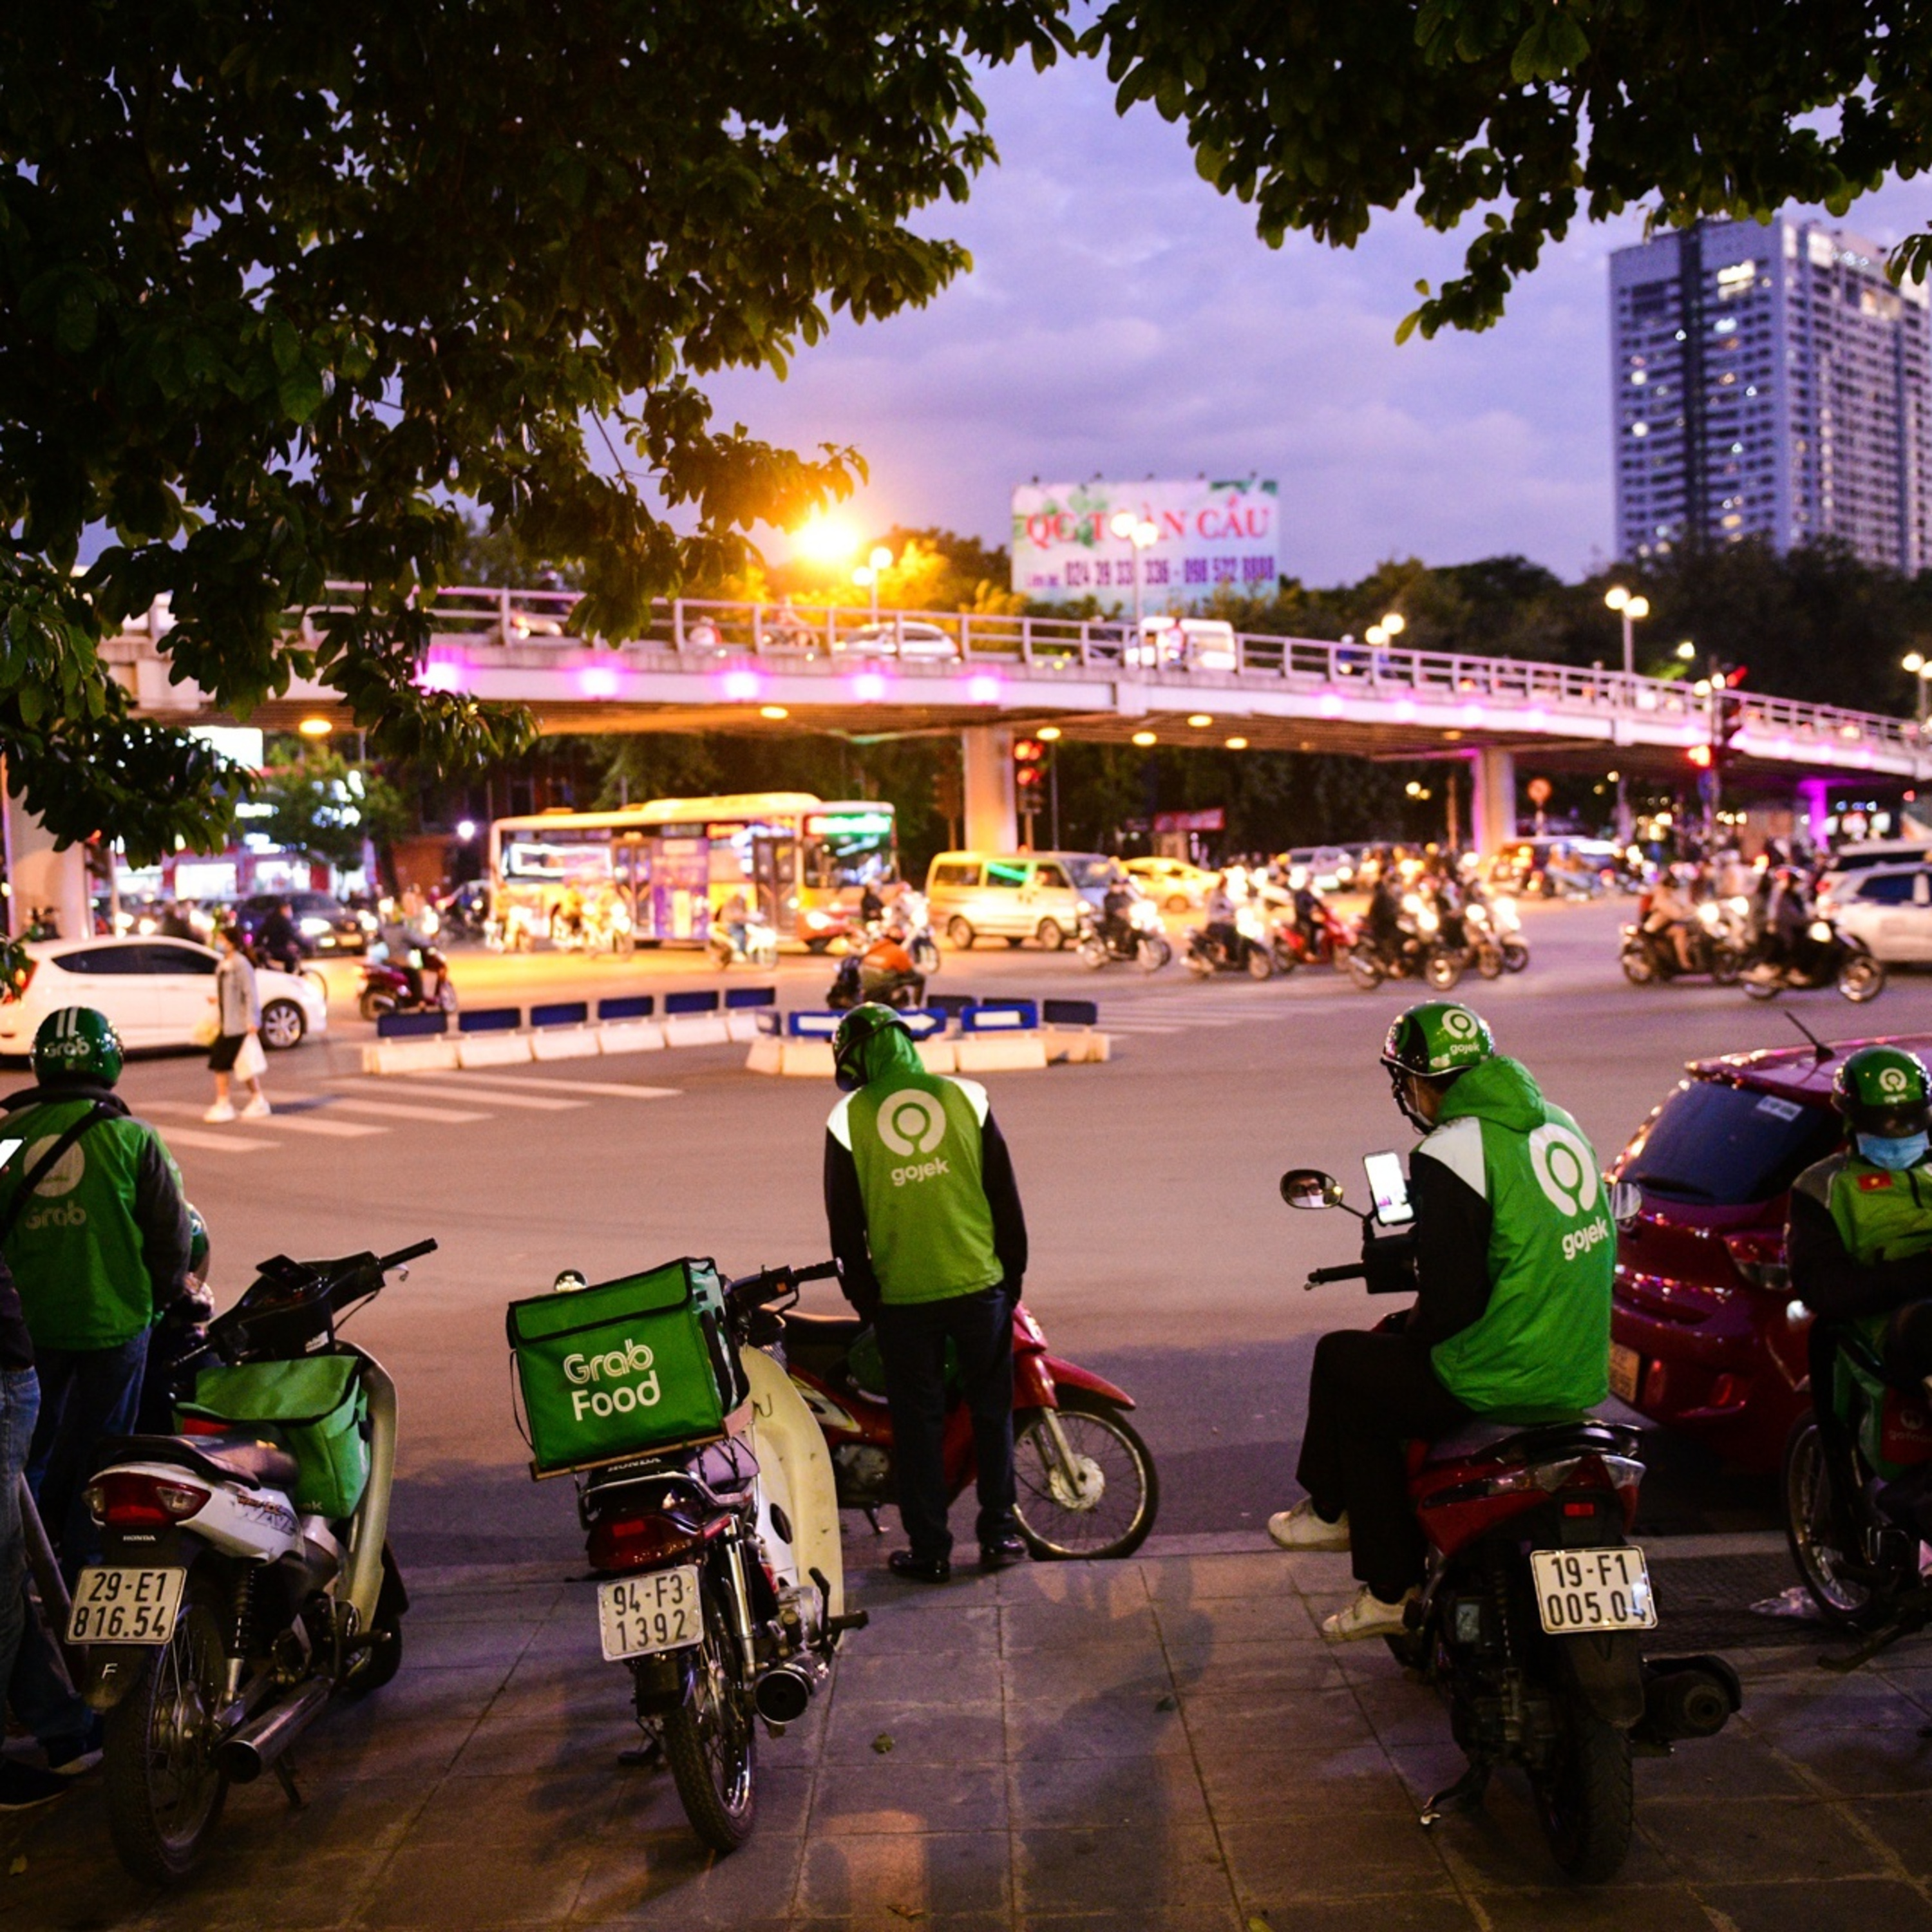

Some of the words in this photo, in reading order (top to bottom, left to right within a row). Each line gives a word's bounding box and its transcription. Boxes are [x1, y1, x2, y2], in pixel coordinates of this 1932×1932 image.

[43, 1036, 91, 1058] Grab
[1450, 1041, 1481, 1056] gojek
[891, 1157, 950, 1187] gojek
[26, 1200, 87, 1229] Grab
[1562, 1217, 1609, 1262] gojek
[563, 1338, 654, 1385] Grab
[571, 1370, 661, 1421] Food
[122, 1533, 156, 1542] HONDA
[88, 1571, 168, 1602] 29-E1
[1550, 1553, 1630, 1588] 19-F1
[613, 1573, 683, 1616] 94-F3
[73, 1606, 166, 1638] 816.54
[616, 1609, 688, 1652] 1392
